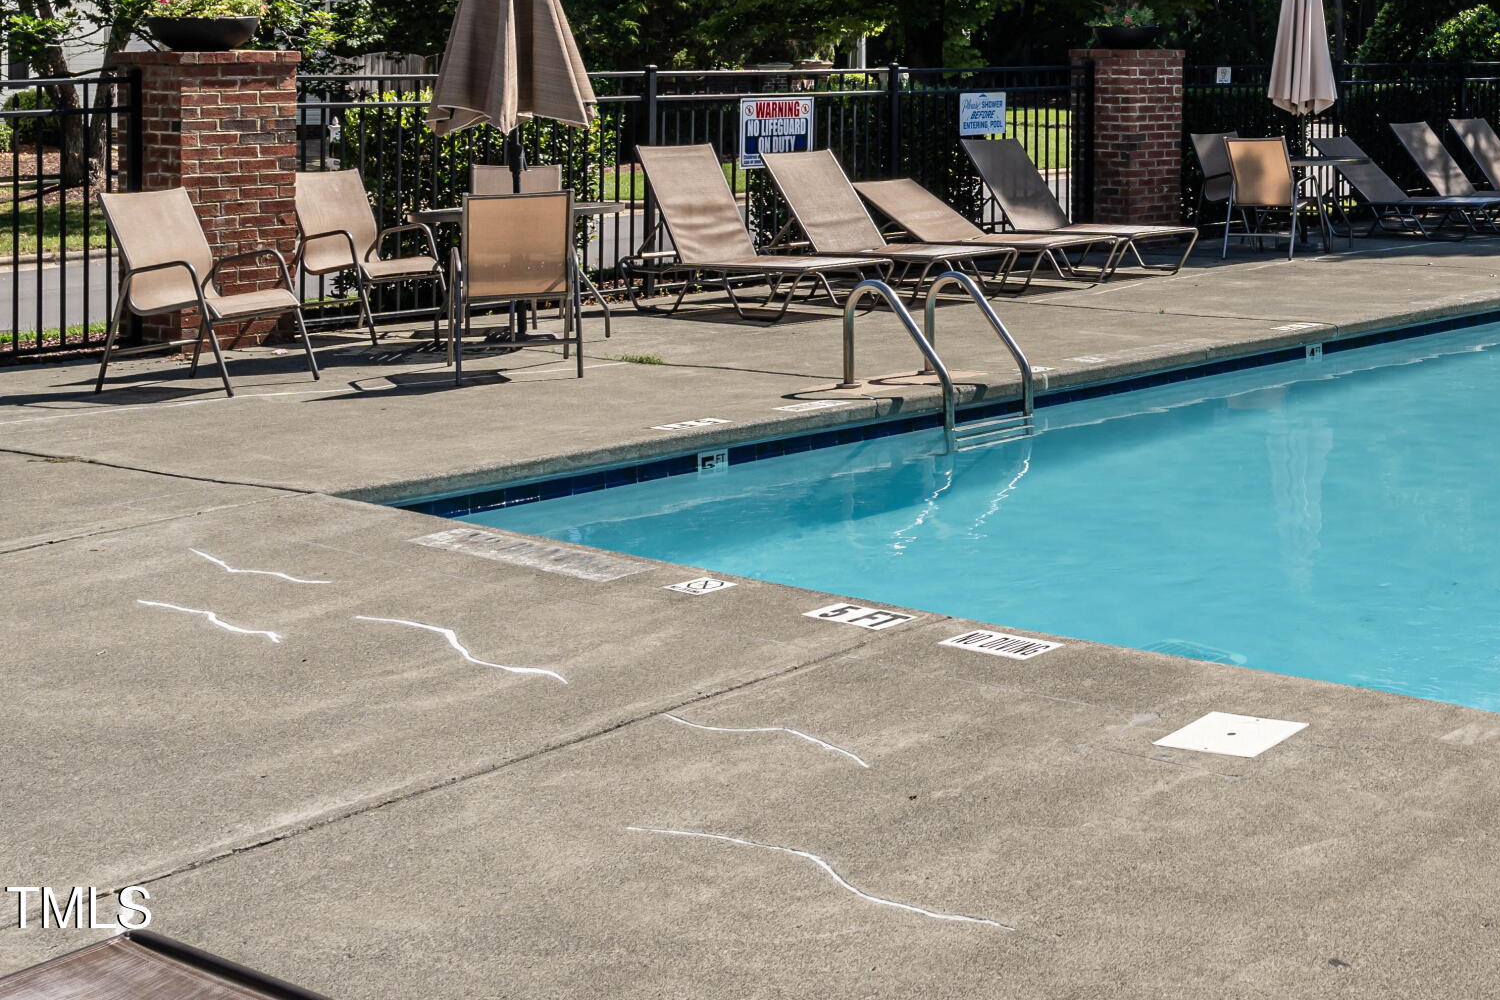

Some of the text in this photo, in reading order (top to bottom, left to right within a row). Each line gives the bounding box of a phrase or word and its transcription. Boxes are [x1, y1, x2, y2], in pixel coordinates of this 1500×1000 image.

[755, 101, 800, 118] WARNING
[981, 100, 1003, 108] SHOWER
[970, 110, 996, 119] BEFORE
[747, 118, 806, 137] NO LIFEGUARD
[963, 120, 1003, 129] ENTERING POOL
[758, 135, 796, 153] ON DUTY
[701, 455, 716, 470] 5
[818, 605, 911, 627] 5 FT
[950, 632, 1050, 656] NO DIVING
